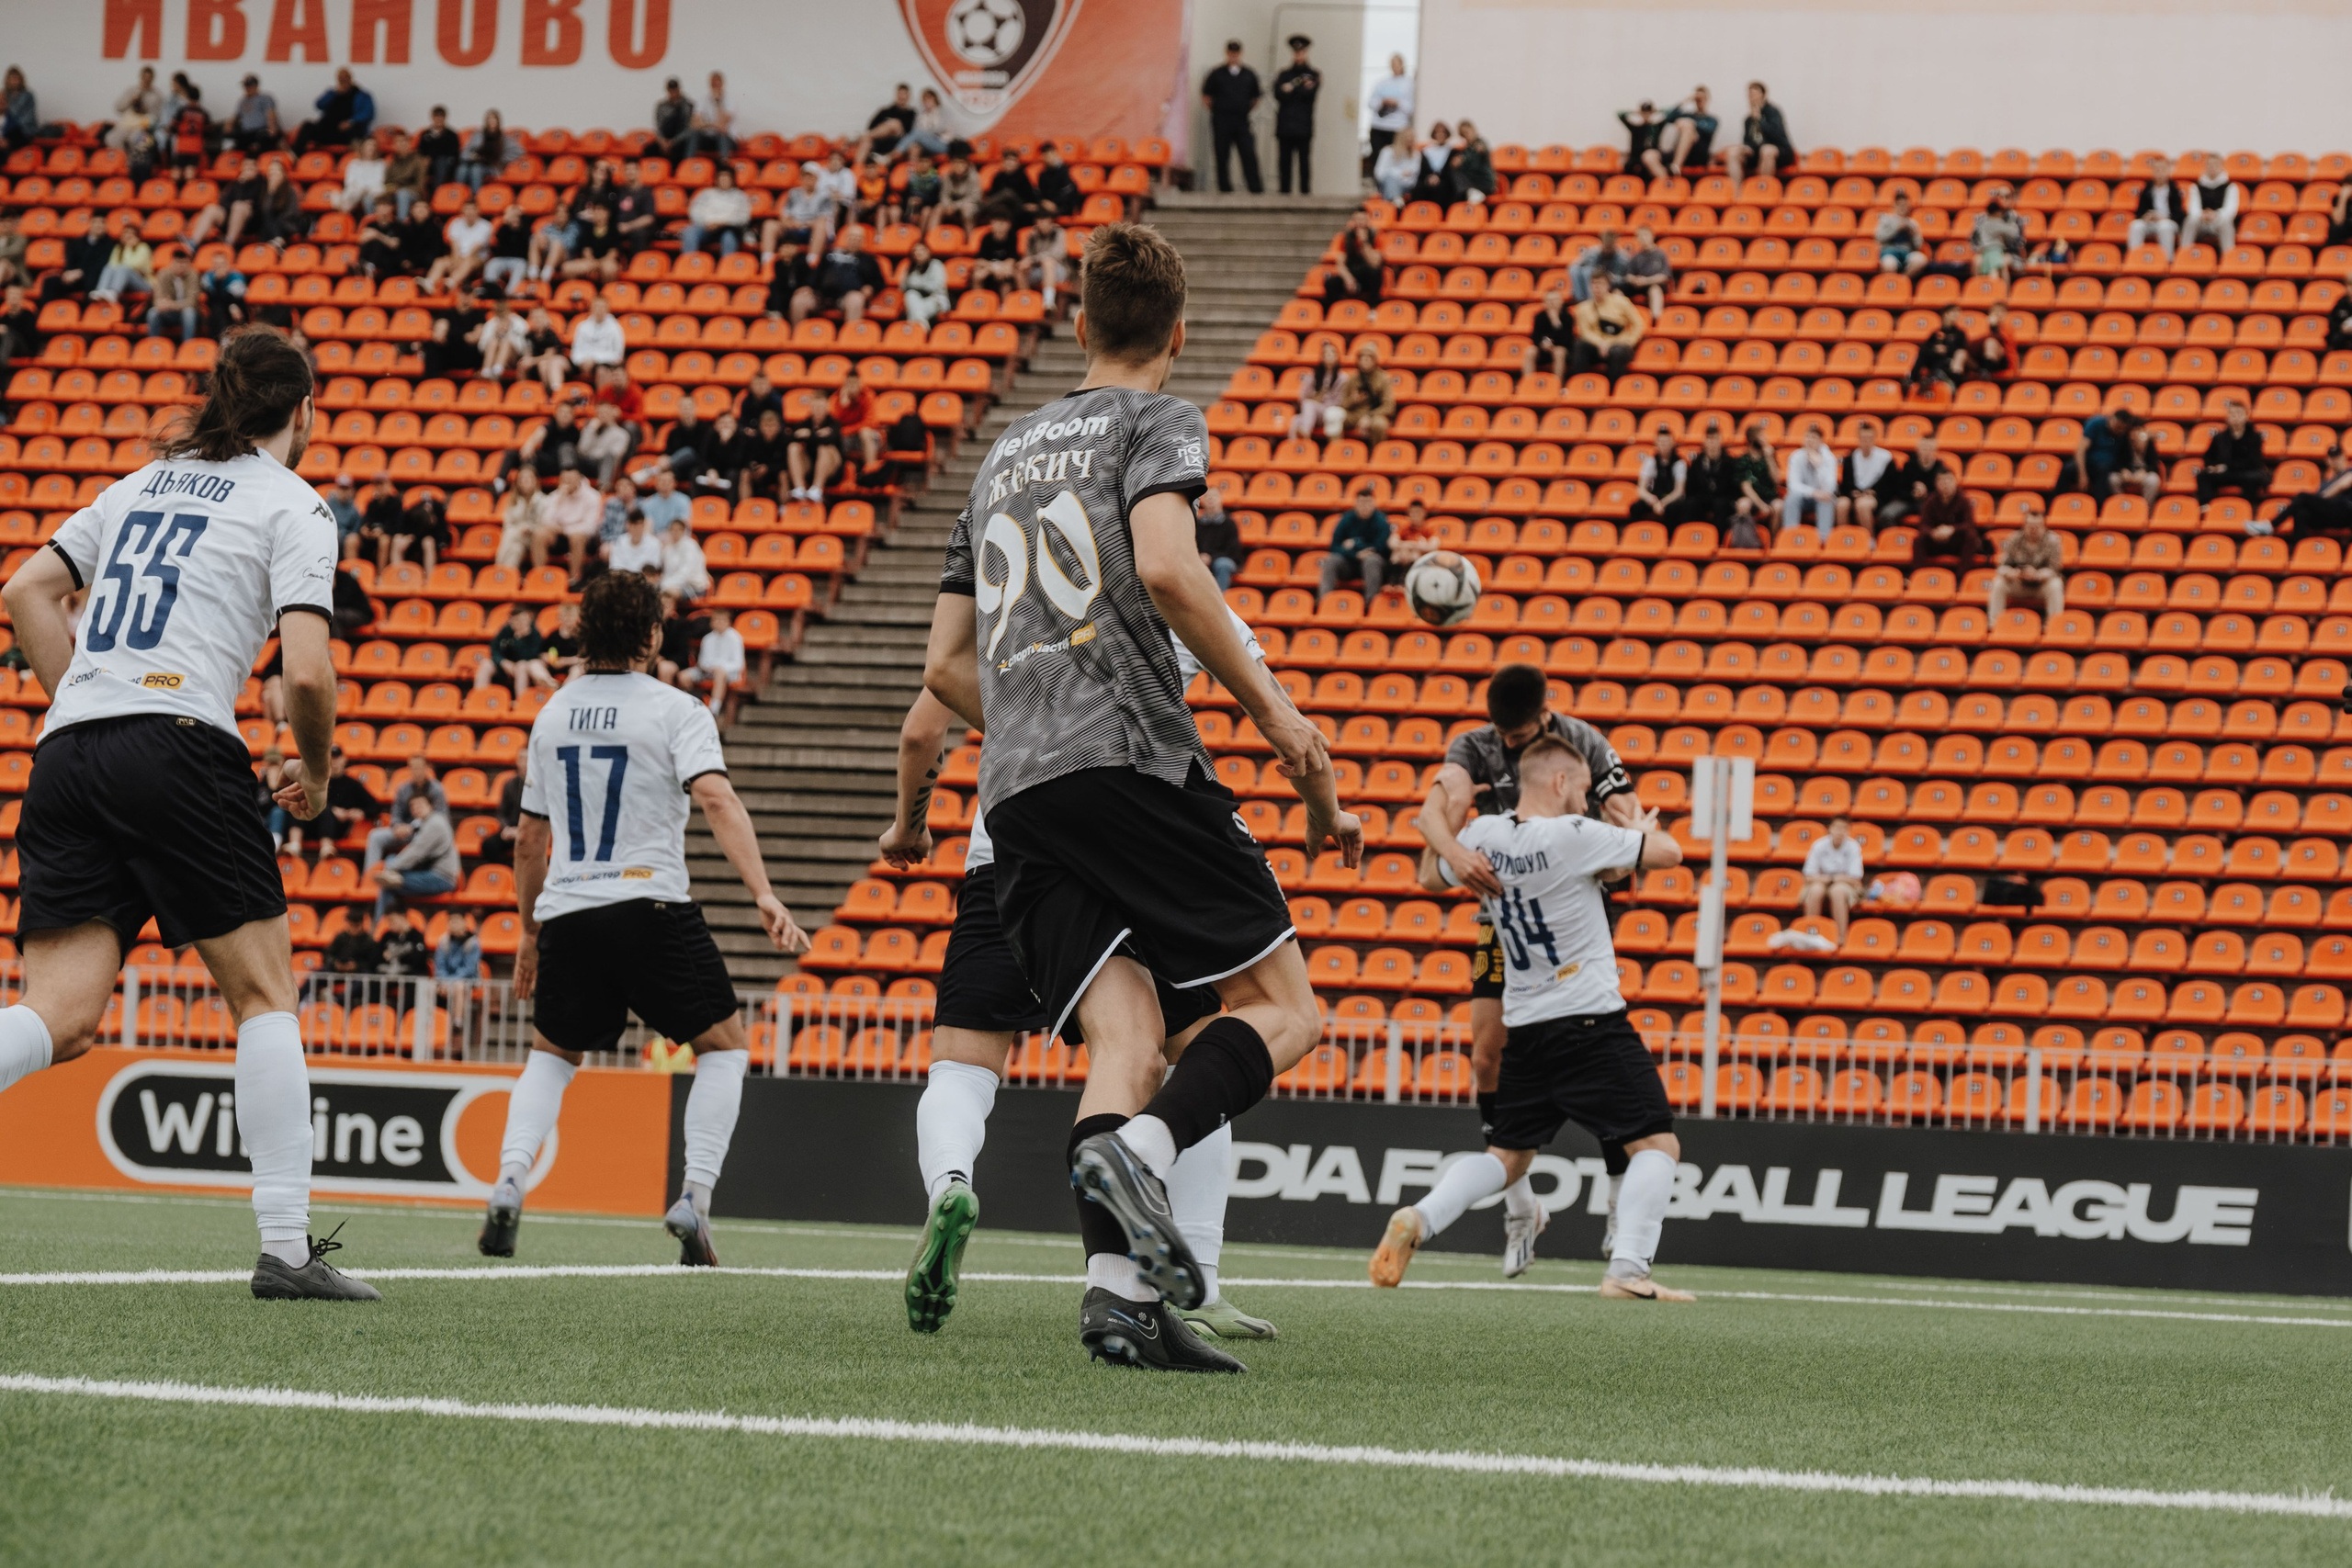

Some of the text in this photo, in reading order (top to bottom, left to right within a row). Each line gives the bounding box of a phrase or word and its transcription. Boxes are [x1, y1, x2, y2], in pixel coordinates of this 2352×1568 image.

[991, 415, 1110, 468] BetBoom
[140, 469, 235, 502] ДЬЯКОВ
[86, 511, 209, 652] 55
[976, 491, 1102, 661] 90
[143, 675, 181, 687] PRO
[569, 706, 617, 730] ТИГА
[557, 745, 628, 862] 17
[140, 1089, 424, 1167] Wiine
[1876, 1172, 2259, 1246] LEAGUE
